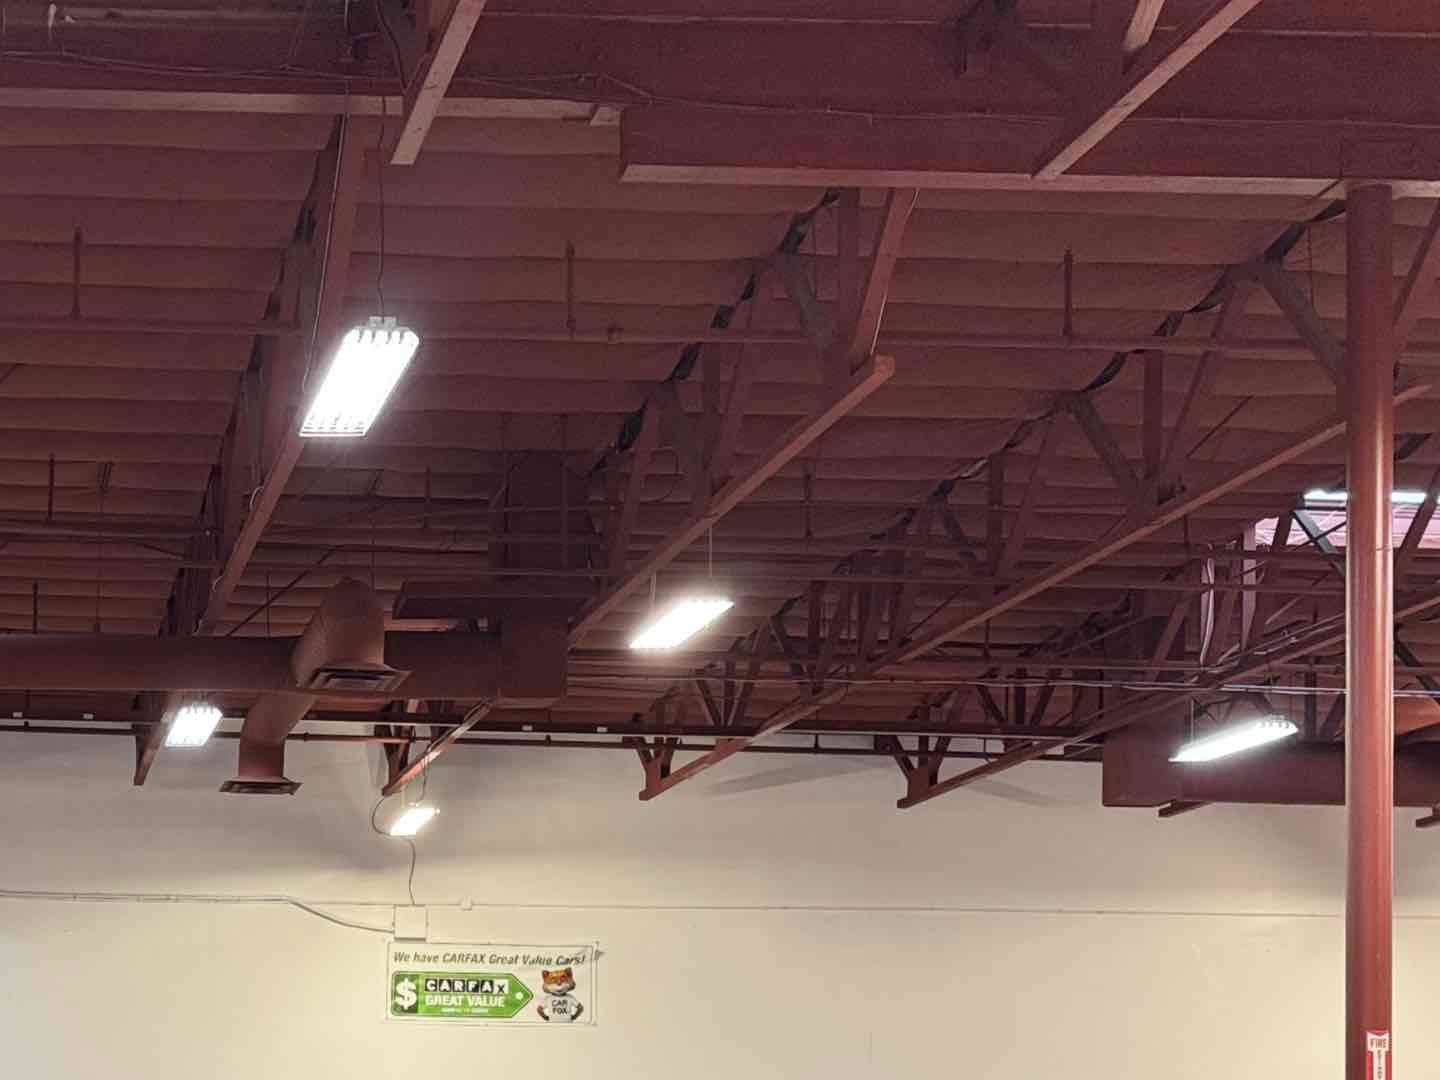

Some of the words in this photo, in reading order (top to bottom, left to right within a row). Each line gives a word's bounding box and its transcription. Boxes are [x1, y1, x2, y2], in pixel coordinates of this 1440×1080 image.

[394, 952, 410, 962] We
[413, 952, 440, 963] have
[442, 952, 486, 964] CARFAX
[488, 953, 519, 965] Great
[555, 955, 586, 966] Cars!
[425, 979, 509, 994] CARFAX
[425, 994, 464, 1007] GREAT
[467, 995, 505, 1008] VALUE
[551, 1007, 568, 1015] FOX
[1370, 1038, 1386, 1049] FIRE
